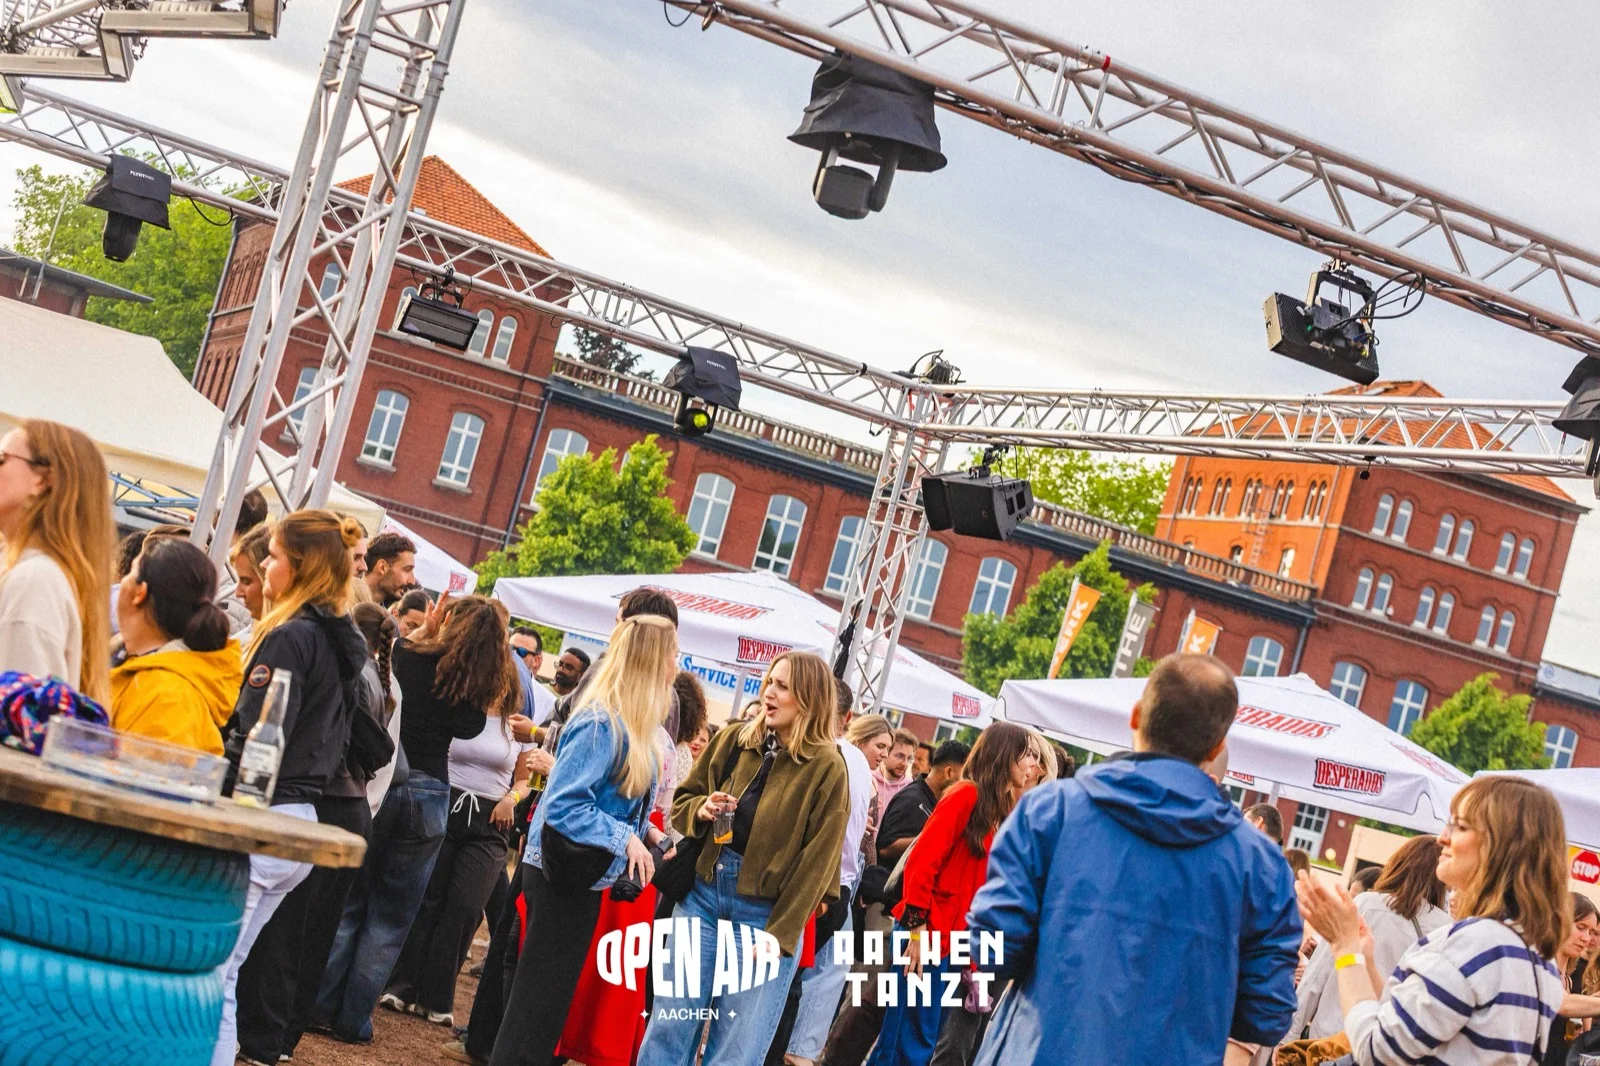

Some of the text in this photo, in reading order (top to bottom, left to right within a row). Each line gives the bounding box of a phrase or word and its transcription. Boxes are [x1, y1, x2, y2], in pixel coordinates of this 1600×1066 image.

[739, 637, 792, 663] DESPERAD
[1316, 759, 1385, 794] DESPERADOS
[1572, 860, 1600, 880] STOP
